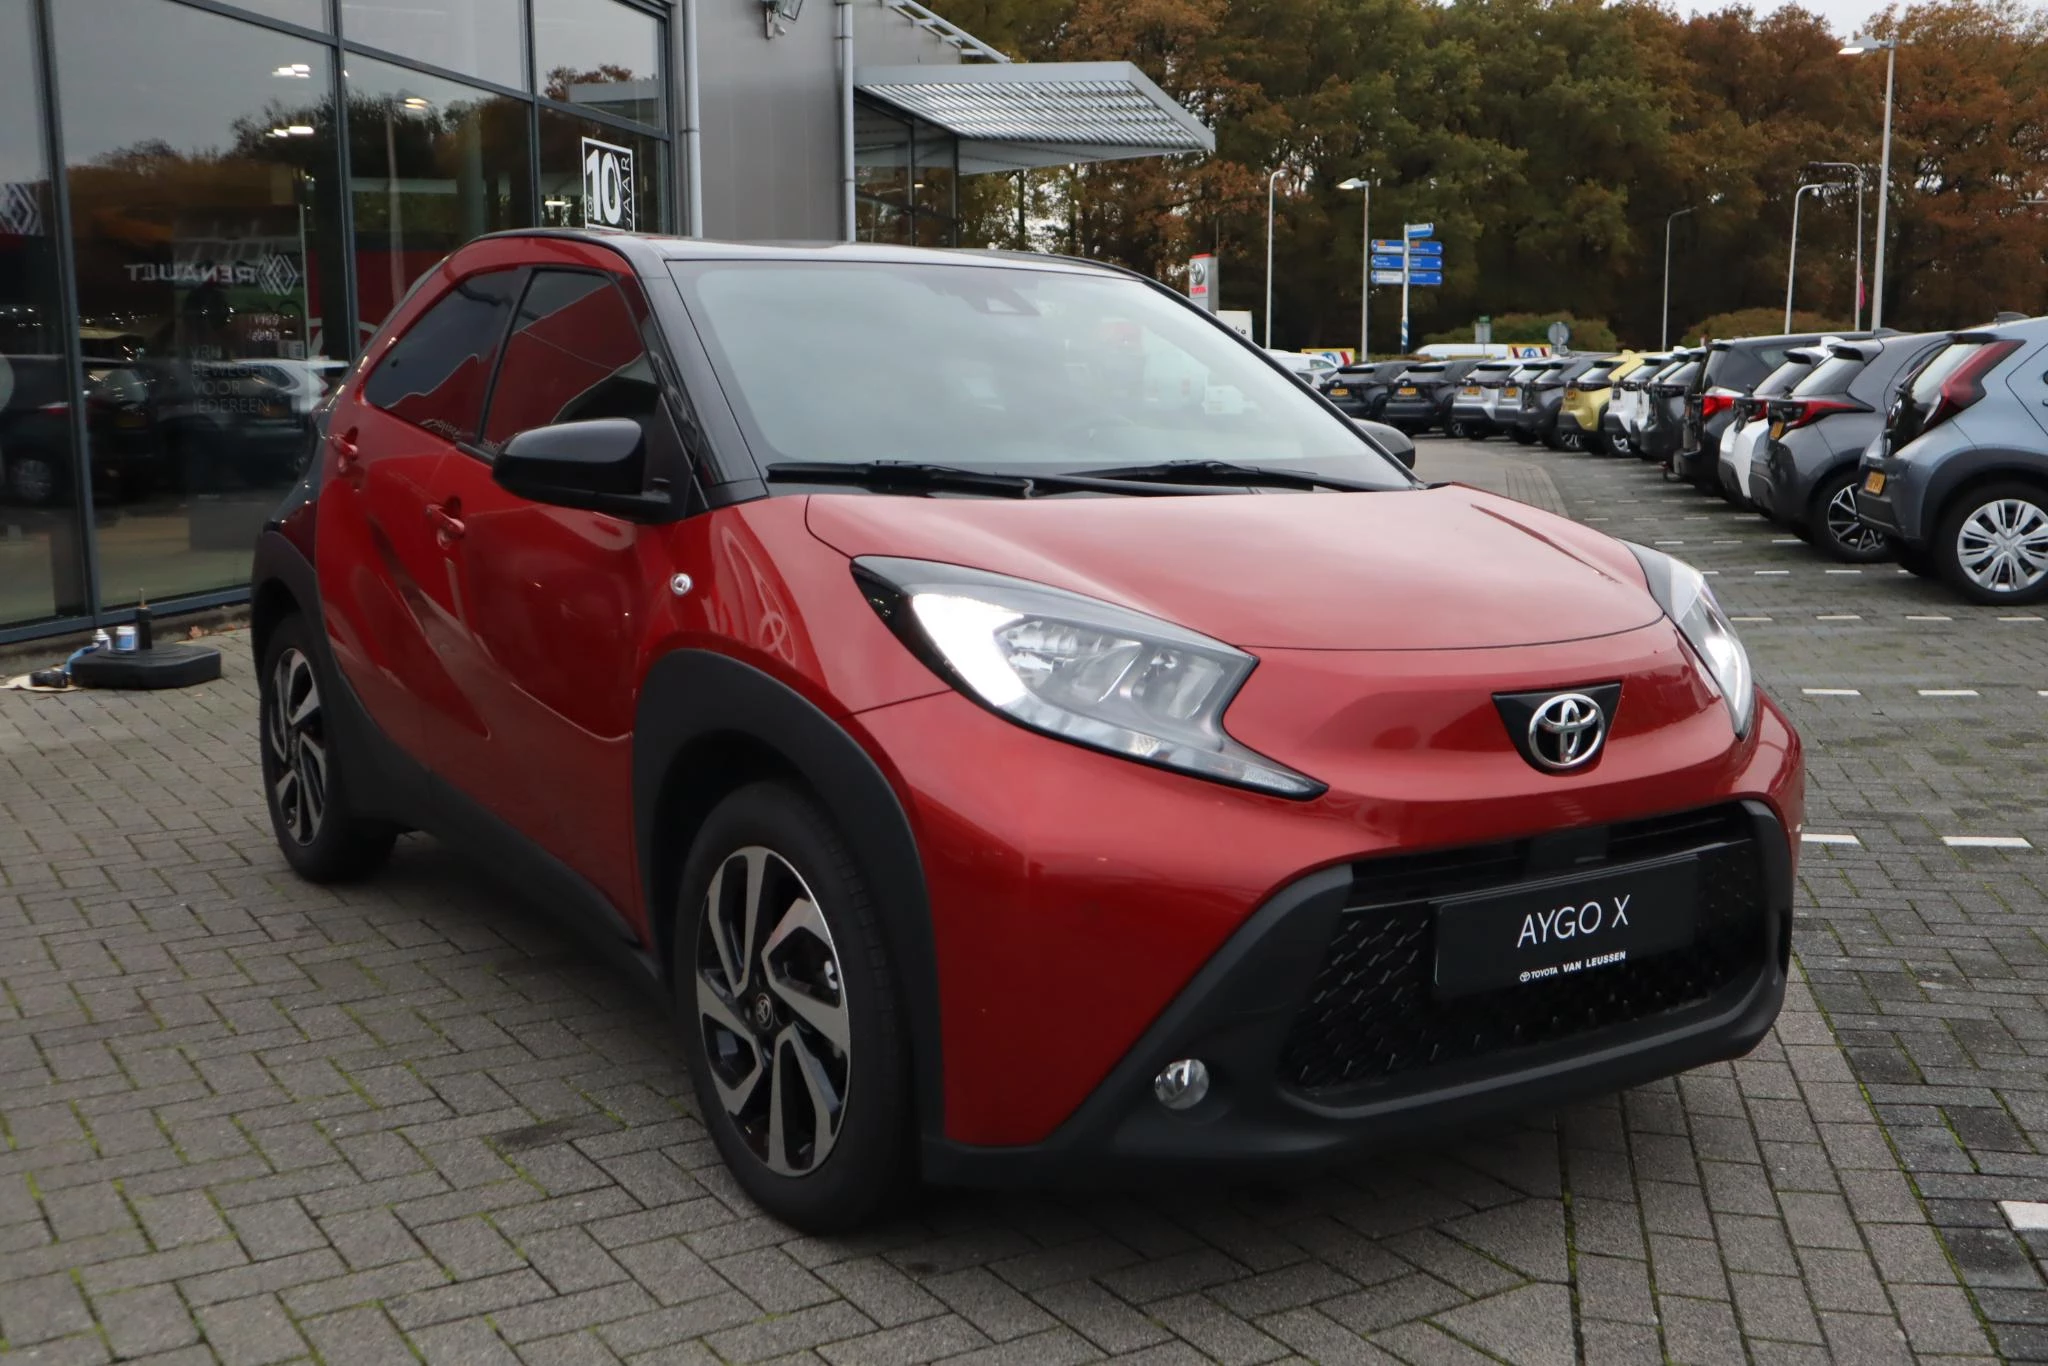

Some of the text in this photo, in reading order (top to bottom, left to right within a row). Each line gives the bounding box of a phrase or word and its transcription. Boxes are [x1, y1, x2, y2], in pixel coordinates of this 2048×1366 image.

[586, 149, 621, 225] 10
[621, 157, 632, 227] JAAR
[1517, 894, 1630, 948] AYGO X
[1530, 951, 1627, 979] TOYOTA VAN LEUSSEN
